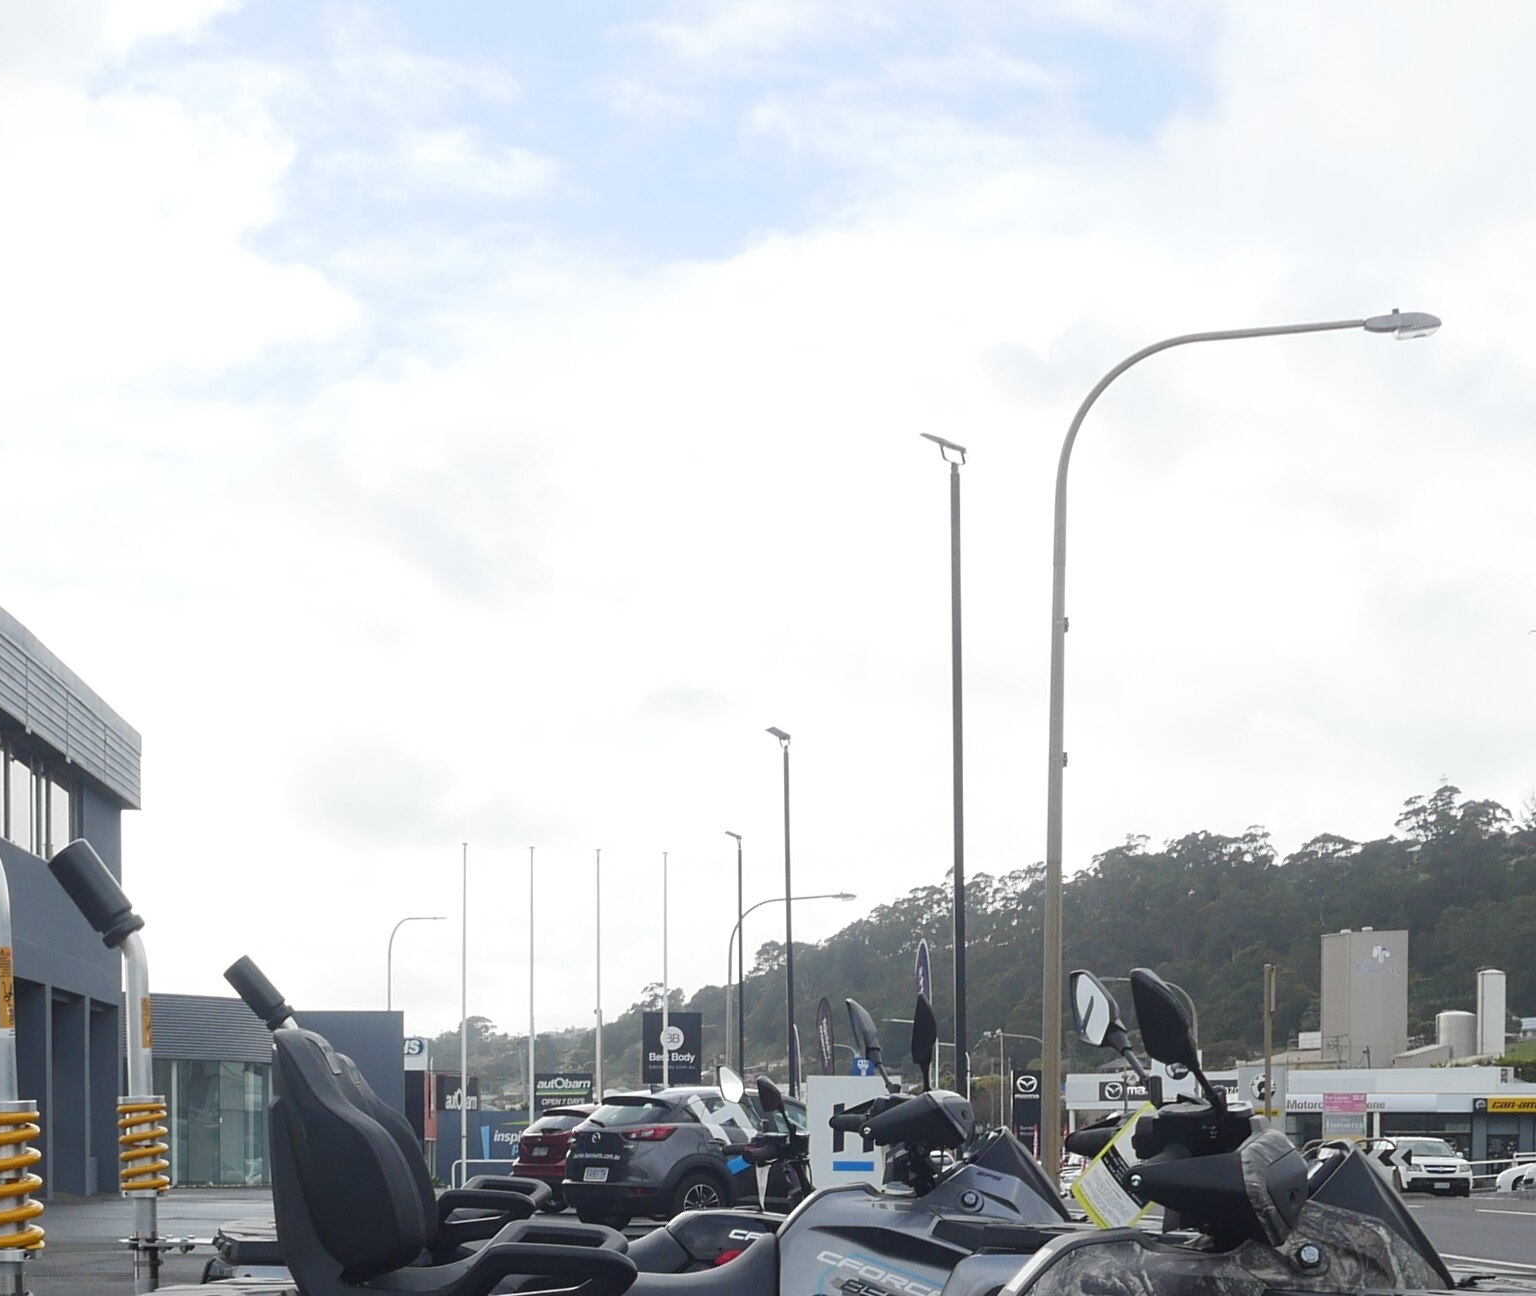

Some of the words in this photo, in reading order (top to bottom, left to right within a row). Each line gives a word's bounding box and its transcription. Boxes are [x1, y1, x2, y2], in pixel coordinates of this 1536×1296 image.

[649, 1052, 669, 1061] Be
[671, 1052, 695, 1063] Body
[1286, 1100, 1323, 1110] Motorc
[494, 1130, 523, 1145] inspi
